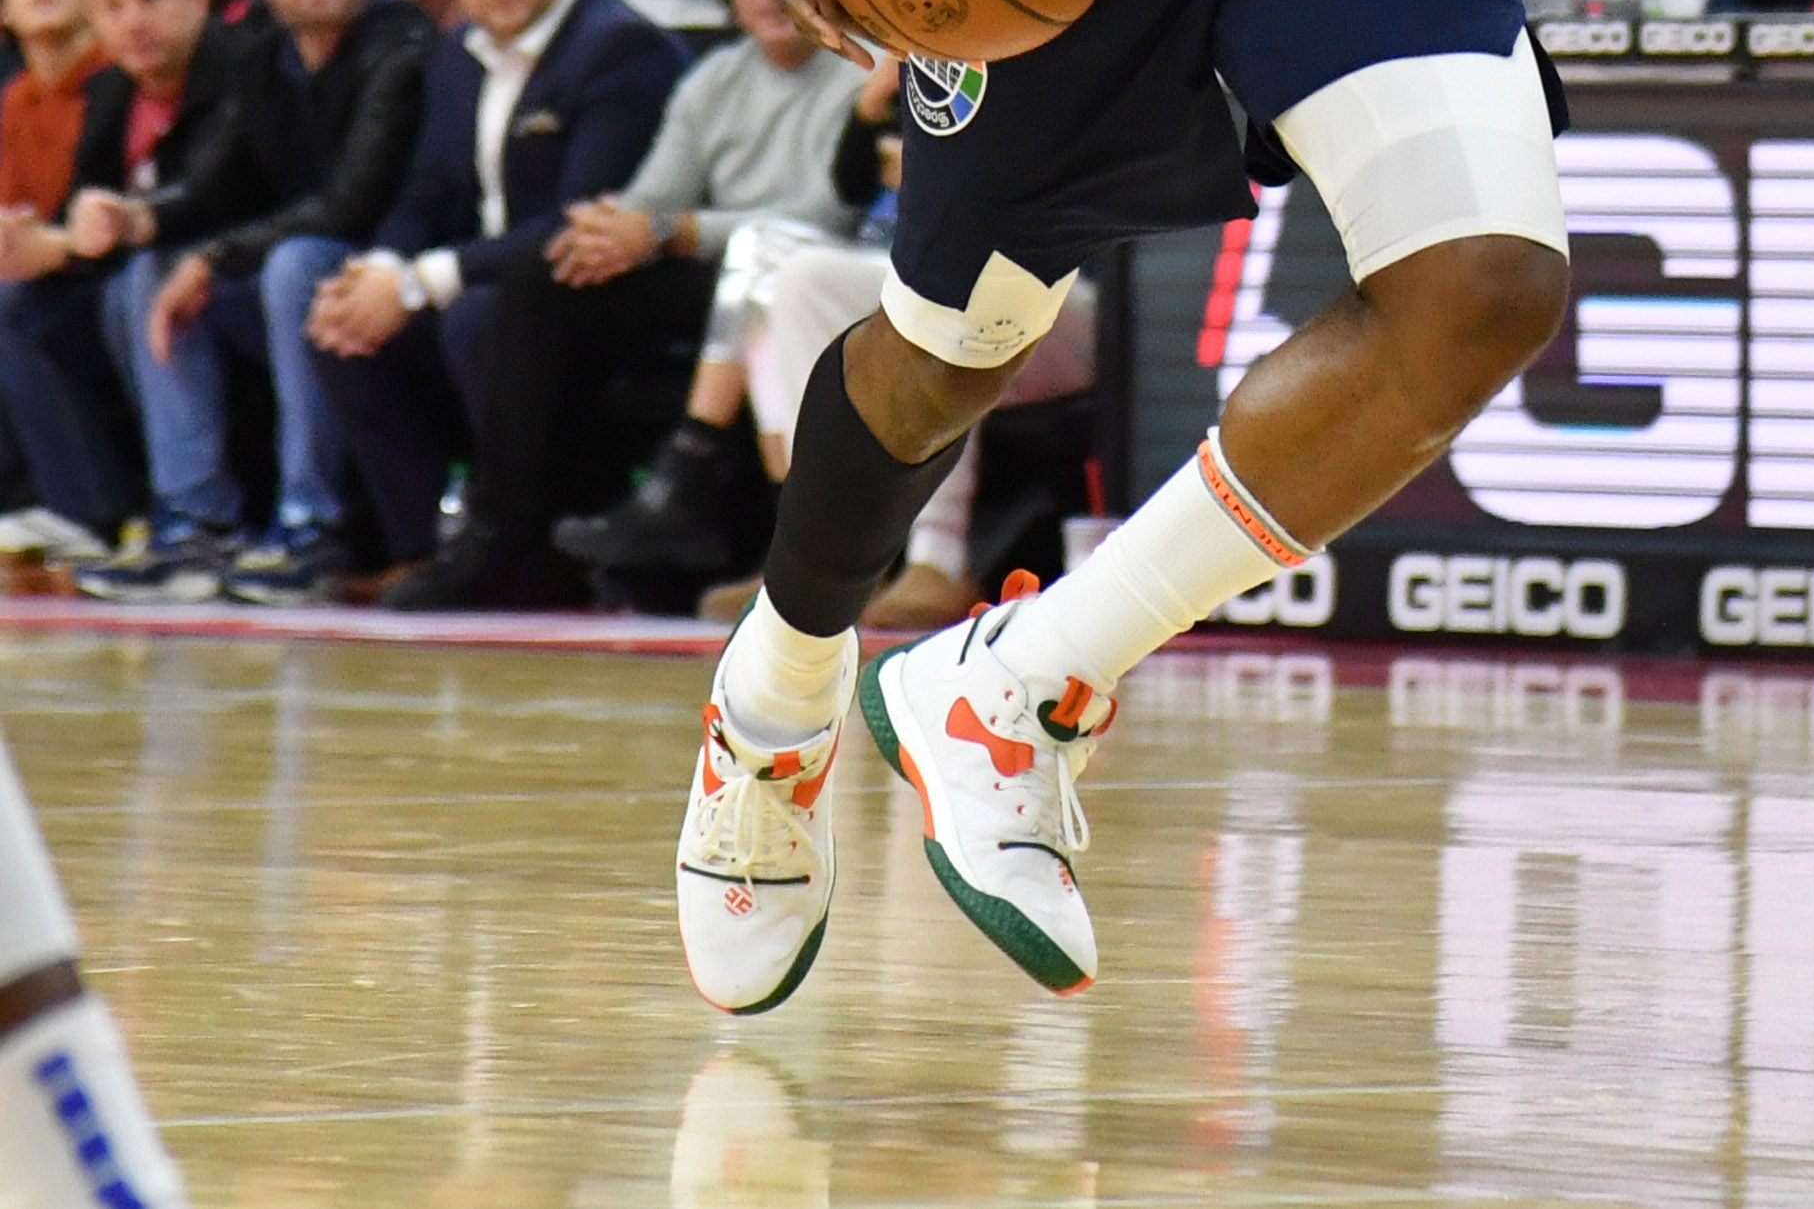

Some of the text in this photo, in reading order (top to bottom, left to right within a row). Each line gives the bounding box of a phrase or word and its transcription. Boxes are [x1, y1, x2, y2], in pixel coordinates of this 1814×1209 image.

[1536, 21, 1631, 56] GEICO
[1639, 21, 1736, 56] GEICO
[1388, 553, 1627, 640] GEICO
